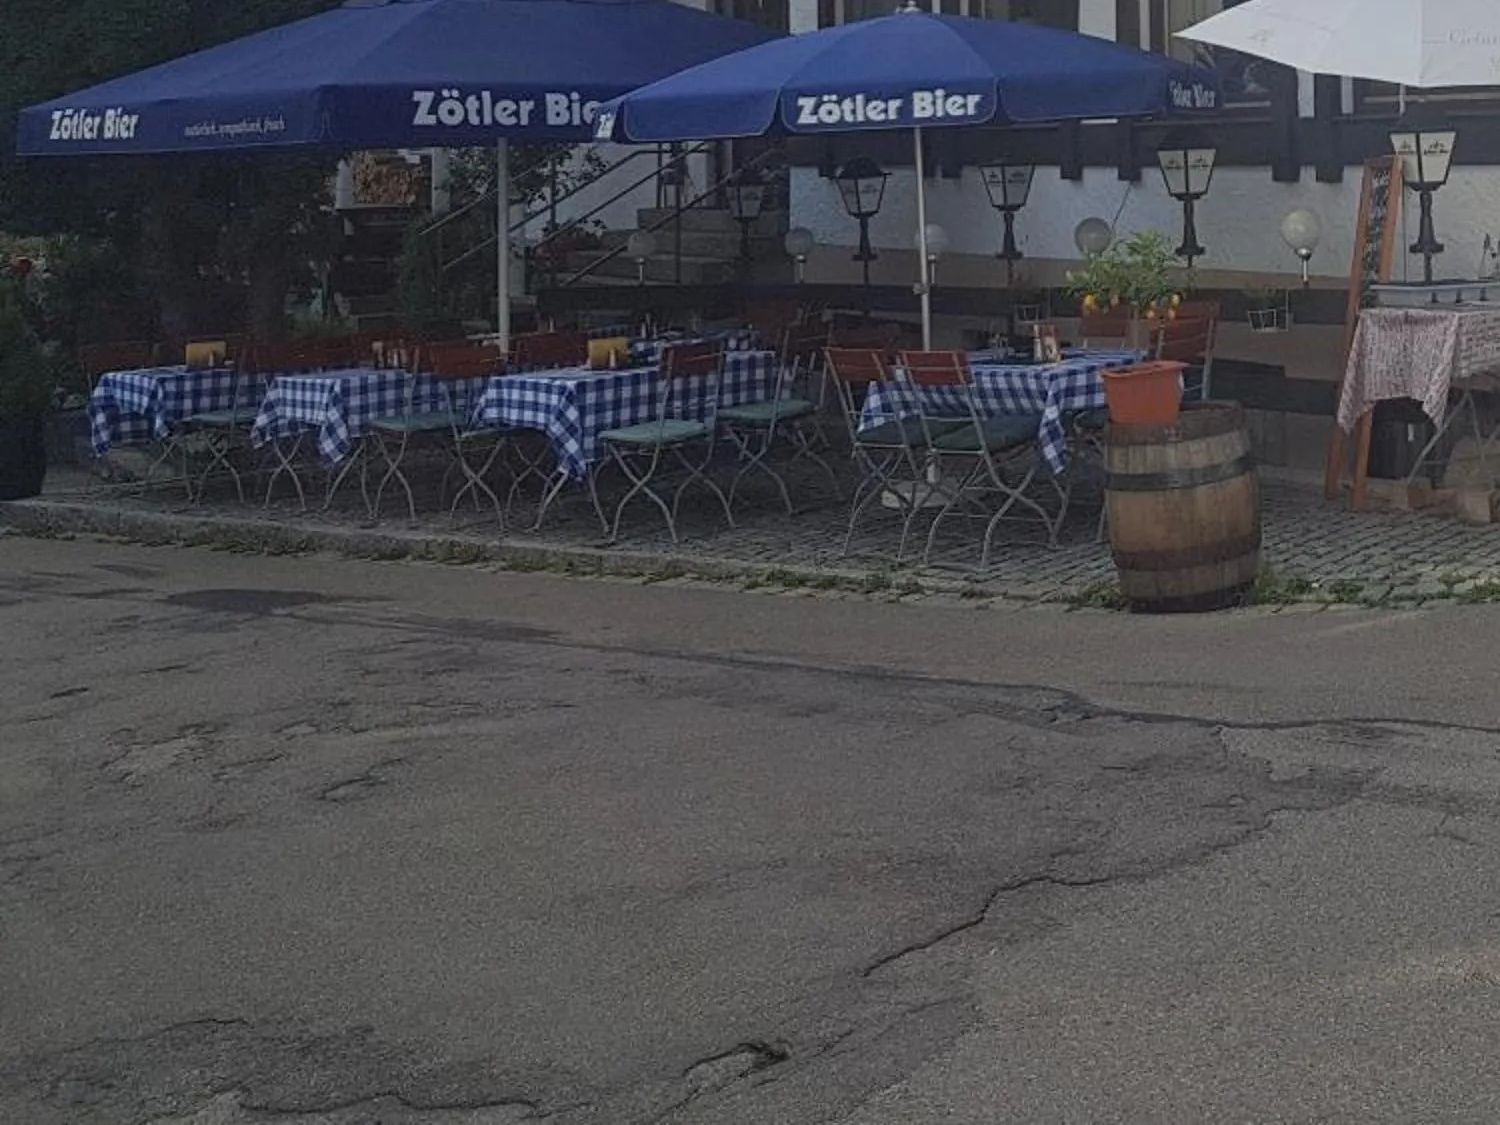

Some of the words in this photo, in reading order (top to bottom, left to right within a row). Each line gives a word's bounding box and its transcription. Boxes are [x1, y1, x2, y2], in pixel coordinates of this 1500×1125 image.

[50, 108, 101, 140] Zötler
[103, 106, 139, 139] Bier
[412, 88, 534, 126] Zötler
[544, 91, 602, 125] Bie
[797, 93, 903, 125] Zötler
[912, 88, 983, 119] Bier
